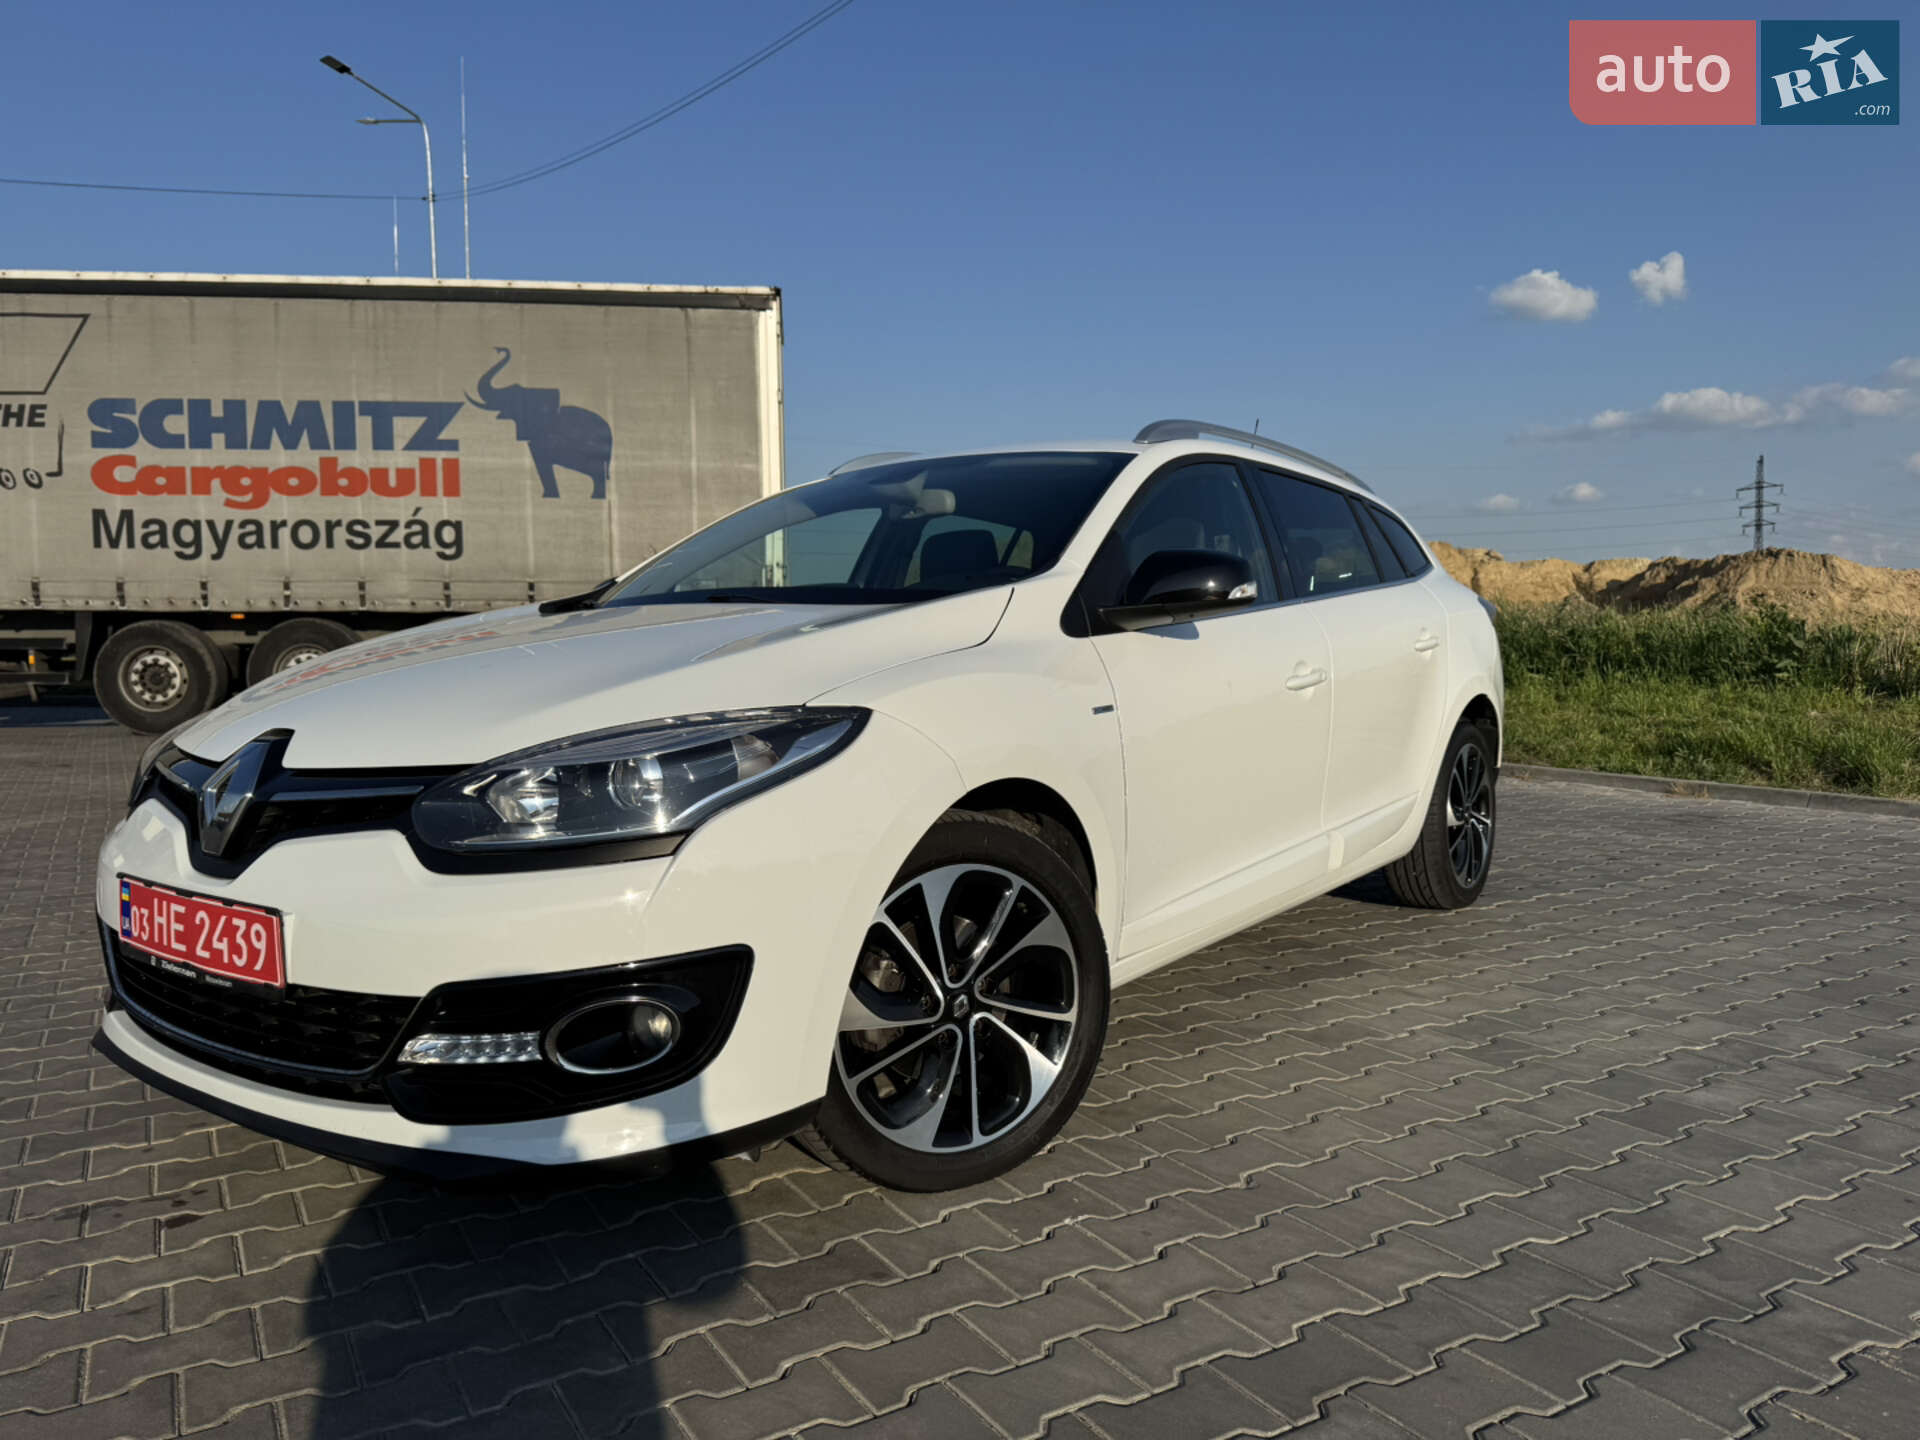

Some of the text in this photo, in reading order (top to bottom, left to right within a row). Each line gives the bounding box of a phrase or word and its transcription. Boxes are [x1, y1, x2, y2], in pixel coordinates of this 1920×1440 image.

[0, 404, 47, 427] HE
[87, 397, 465, 451] SCHMITZ
[90, 454, 461, 510] Cargobull
[92, 507, 464, 561] Magyarország
[153, 898, 187, 952] HE
[194, 910, 267, 971] 2439
